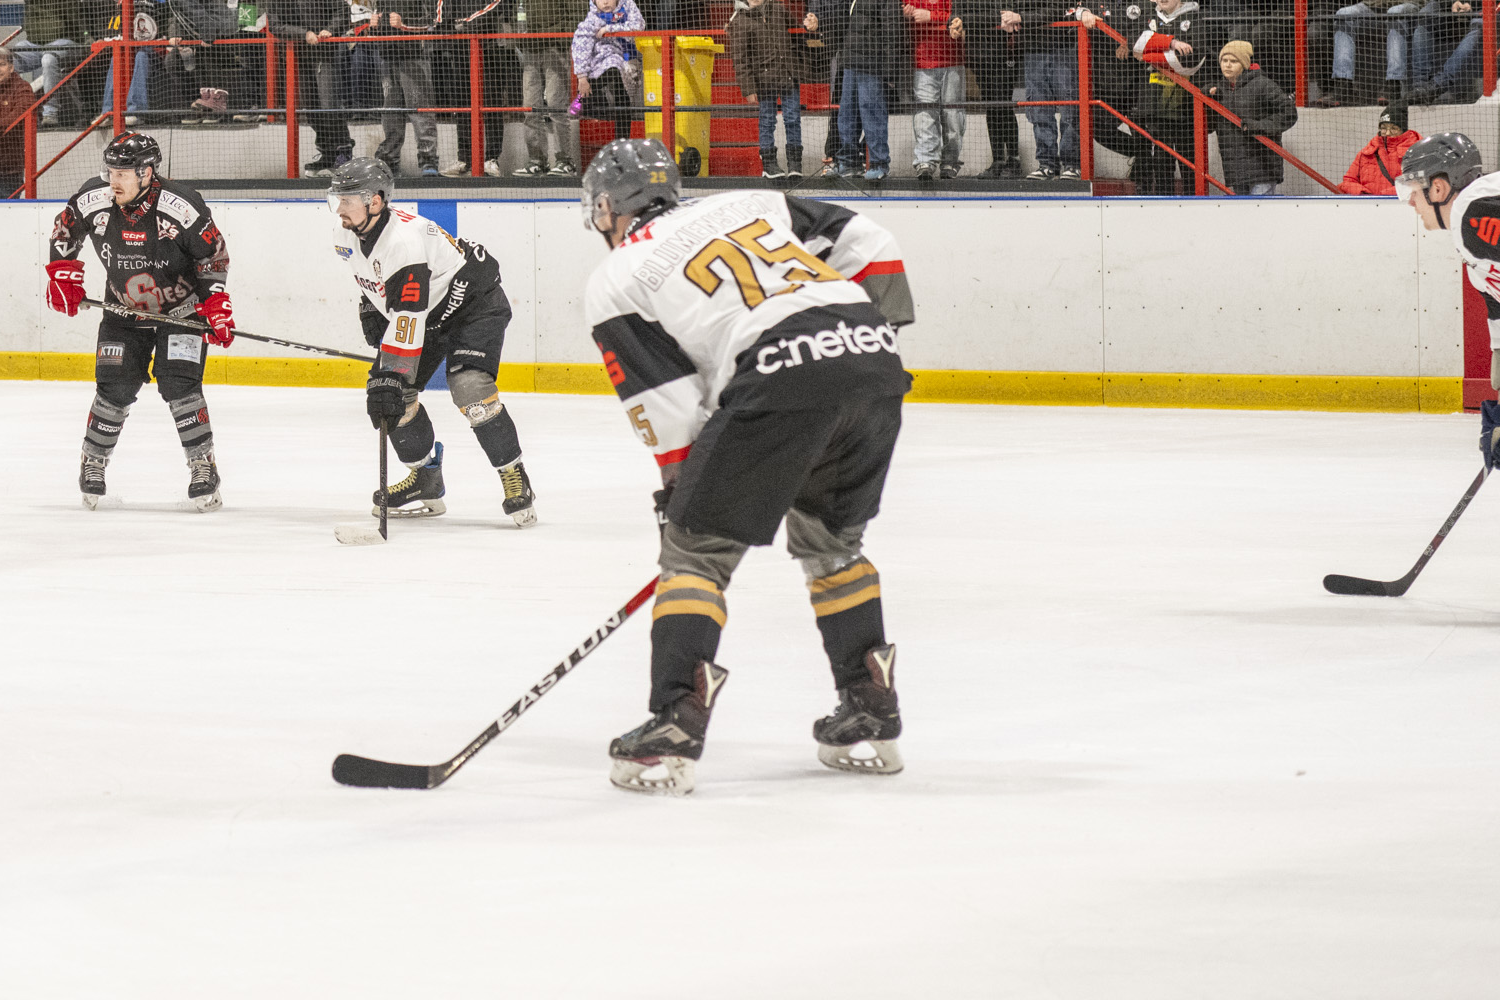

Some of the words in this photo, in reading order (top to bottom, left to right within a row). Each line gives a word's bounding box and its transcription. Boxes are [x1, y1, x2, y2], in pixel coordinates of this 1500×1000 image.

[650, 171, 667, 184] 25
[123, 232, 145, 240] CCM
[117, 260, 170, 270] FELDMANN
[683, 218, 847, 311] 25
[54, 270, 85, 281] CC
[395, 315, 418, 345] 91
[100, 345, 124, 357] KTM
[628, 404, 658, 447] 5
[497, 611, 622, 731] EASTON
